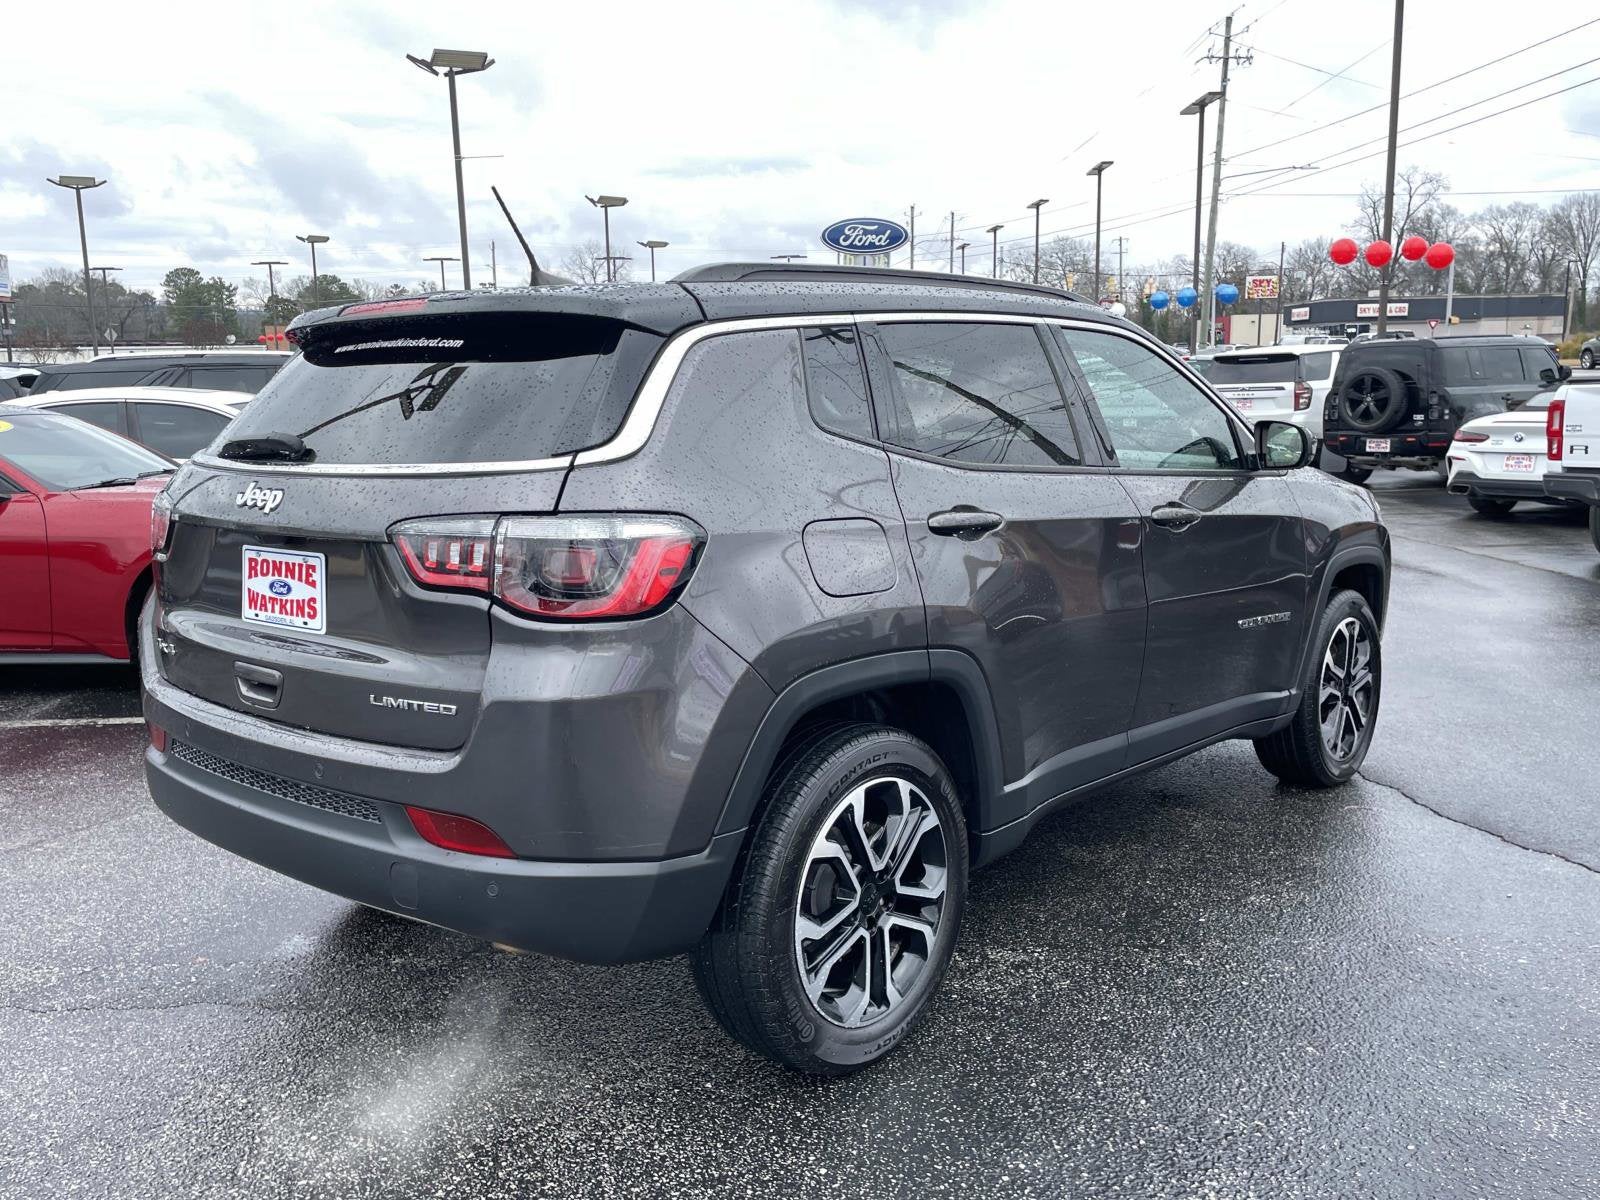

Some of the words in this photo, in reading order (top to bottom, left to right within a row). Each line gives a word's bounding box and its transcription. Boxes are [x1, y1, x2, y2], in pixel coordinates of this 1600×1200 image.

[839, 224, 892, 246] Ford
[1252, 279, 1272, 288] SKY
[235, 481, 284, 514] Jeep
[247, 557, 317, 589] RONNIE
[272, 581, 290, 594] Ford
[247, 587, 318, 620] WATKINS
[369, 694, 457, 716] LIMITED
